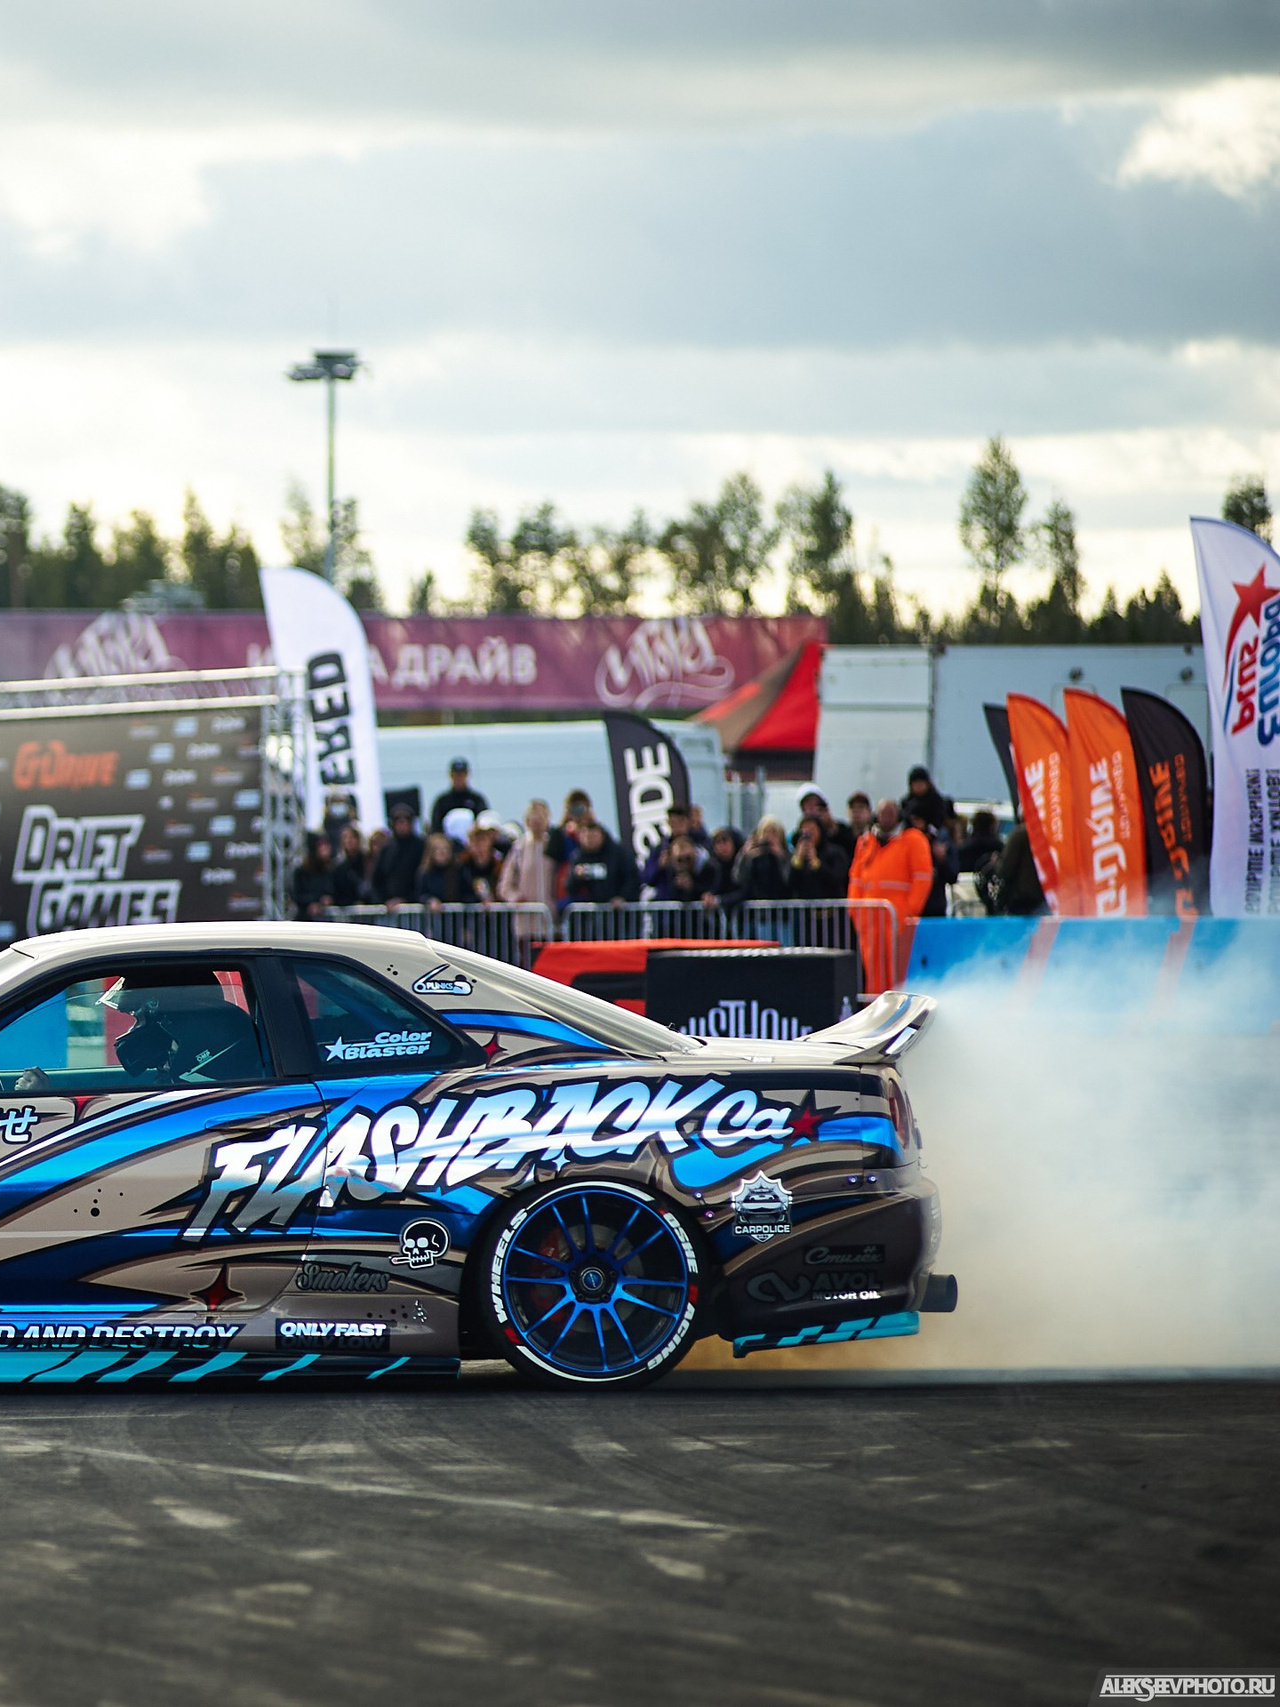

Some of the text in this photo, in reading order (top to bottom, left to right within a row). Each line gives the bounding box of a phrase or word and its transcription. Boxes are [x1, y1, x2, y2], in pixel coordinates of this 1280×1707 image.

[391, 634, 538, 690] ДРАЙВ
[13, 805, 144, 882] DRIFT
[375, 1030, 433, 1044] Color
[344, 1044, 430, 1060] Blaster
[177, 1079, 726, 1243] FLASHBACK
[734, 1224, 791, 1235] CARPOLICE
[490, 1207, 528, 1324] WHEELS
[296, 1262, 391, 1293] Smokers
[859, 1290, 882, 1300] OIL
[18, 1325, 86, 1350] AND
[88, 1325, 240, 1350] DESTROY
[280, 1323, 387, 1337] ONLY FAST
[332, 1337, 387, 1349] LOW
